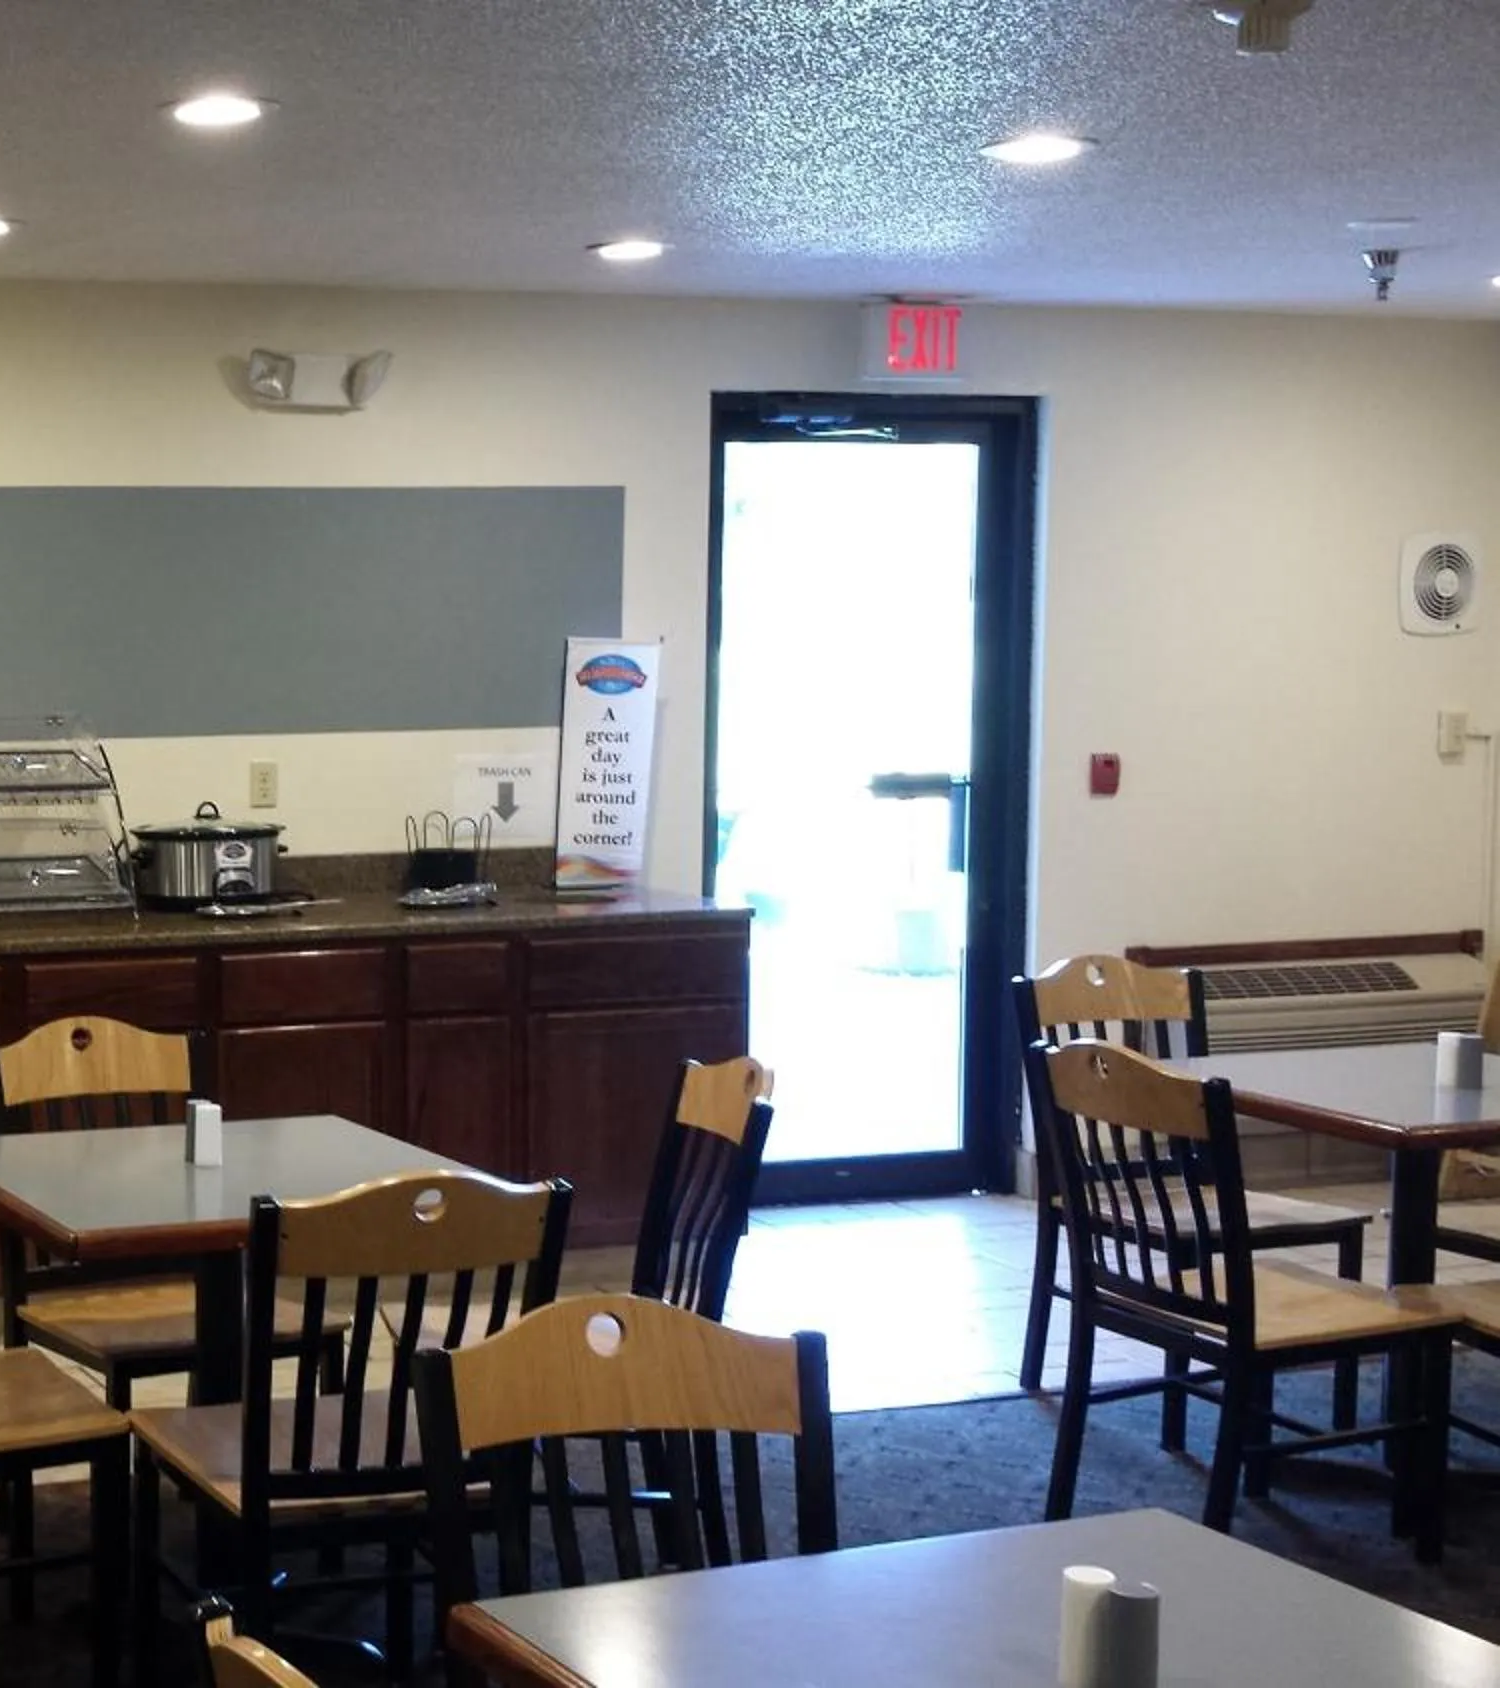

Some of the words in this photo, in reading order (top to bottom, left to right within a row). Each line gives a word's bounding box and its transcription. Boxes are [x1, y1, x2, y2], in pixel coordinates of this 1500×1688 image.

[887, 305, 962, 373] EXIT
[602, 706, 616, 721] A
[585, 729, 630, 746] great
[591, 747, 622, 768] day
[478, 766, 509, 777] TRASH
[510, 766, 532, 777] CAN
[582, 767, 597, 783] is
[601, 768, 632, 787] just
[575, 790, 637, 806] around
[592, 809, 619, 825] the
[573, 831, 634, 847] corner!
